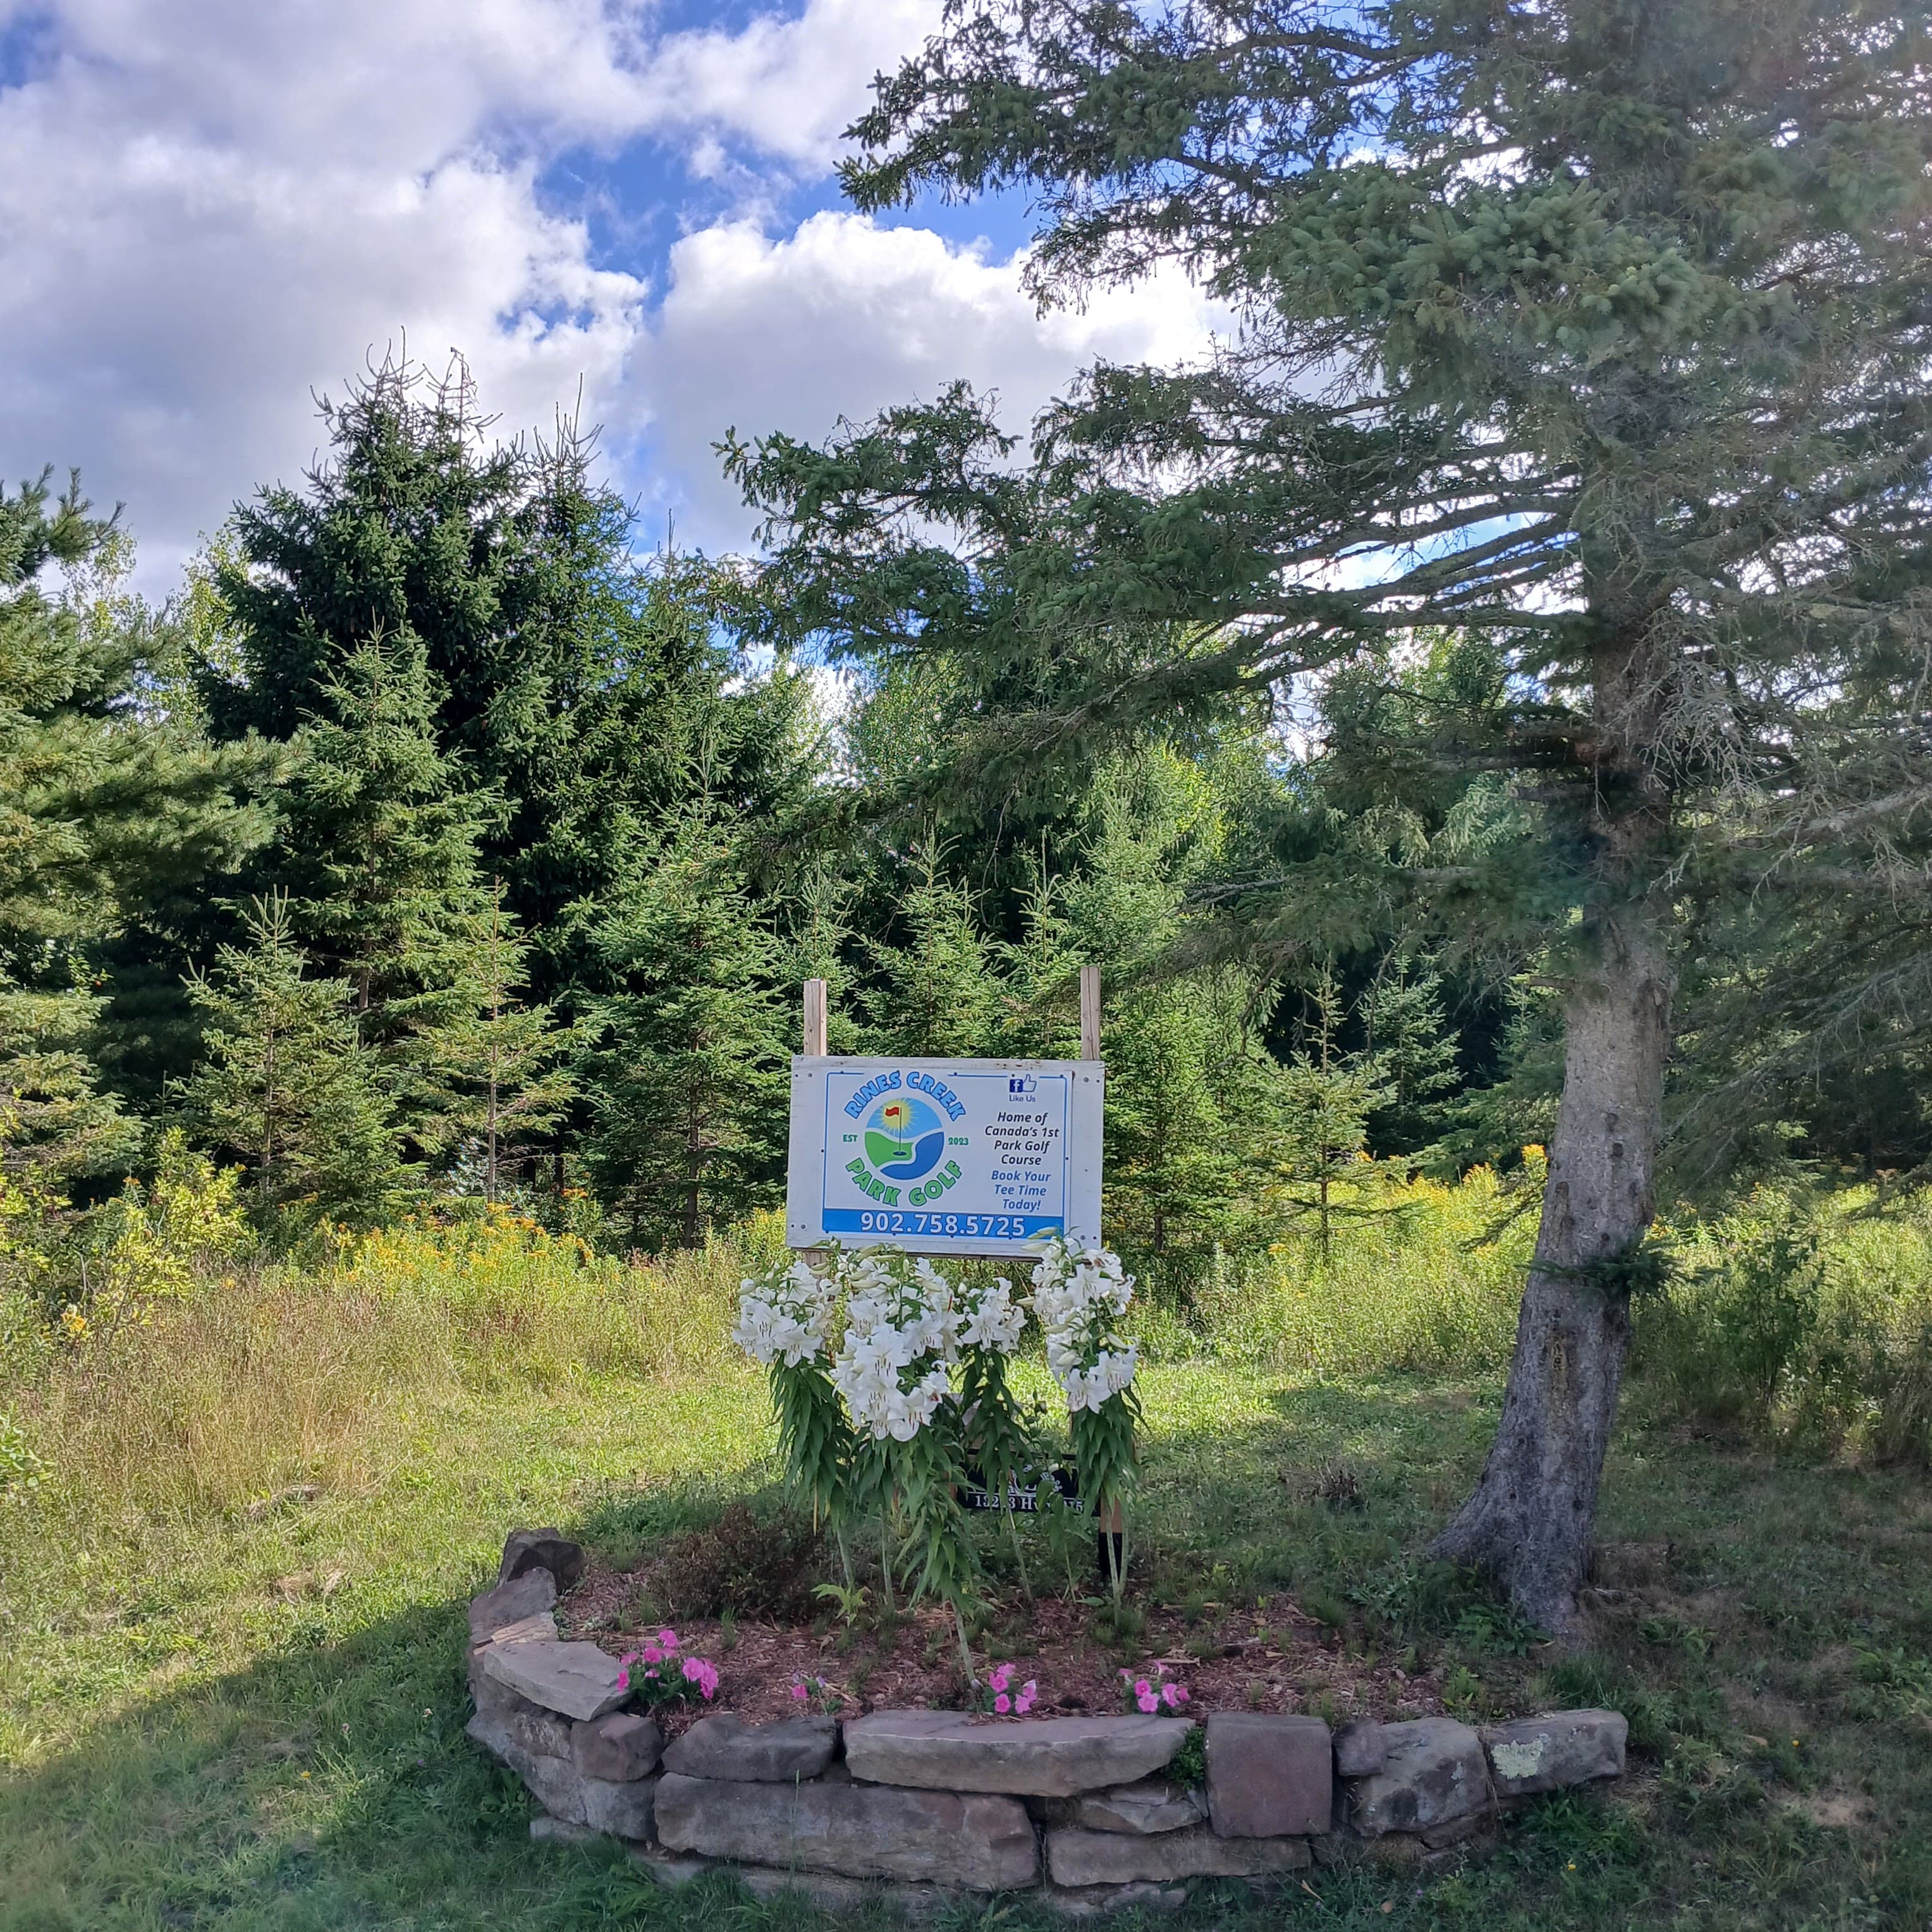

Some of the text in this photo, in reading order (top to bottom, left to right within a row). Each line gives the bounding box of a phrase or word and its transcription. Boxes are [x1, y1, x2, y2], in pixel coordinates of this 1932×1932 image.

[844, 1070, 966, 1122] RINES CREEK
[998, 1111, 1048, 1125] Home of
[985, 1126, 1060, 1137] Canada's 1st
[948, 1137, 969, 1146] 2023
[994, 1140, 1051, 1154] Park Golf
[1001, 1154, 1041, 1165] Course
[845, 1158, 962, 1207] PARK GOLF
[991, 1170, 1051, 1182] Book Your
[994, 1184, 1046, 1195] Tee Time
[1003, 1199, 1041, 1213] Today!
[860, 1212, 1025, 1236] 902.758.5725
